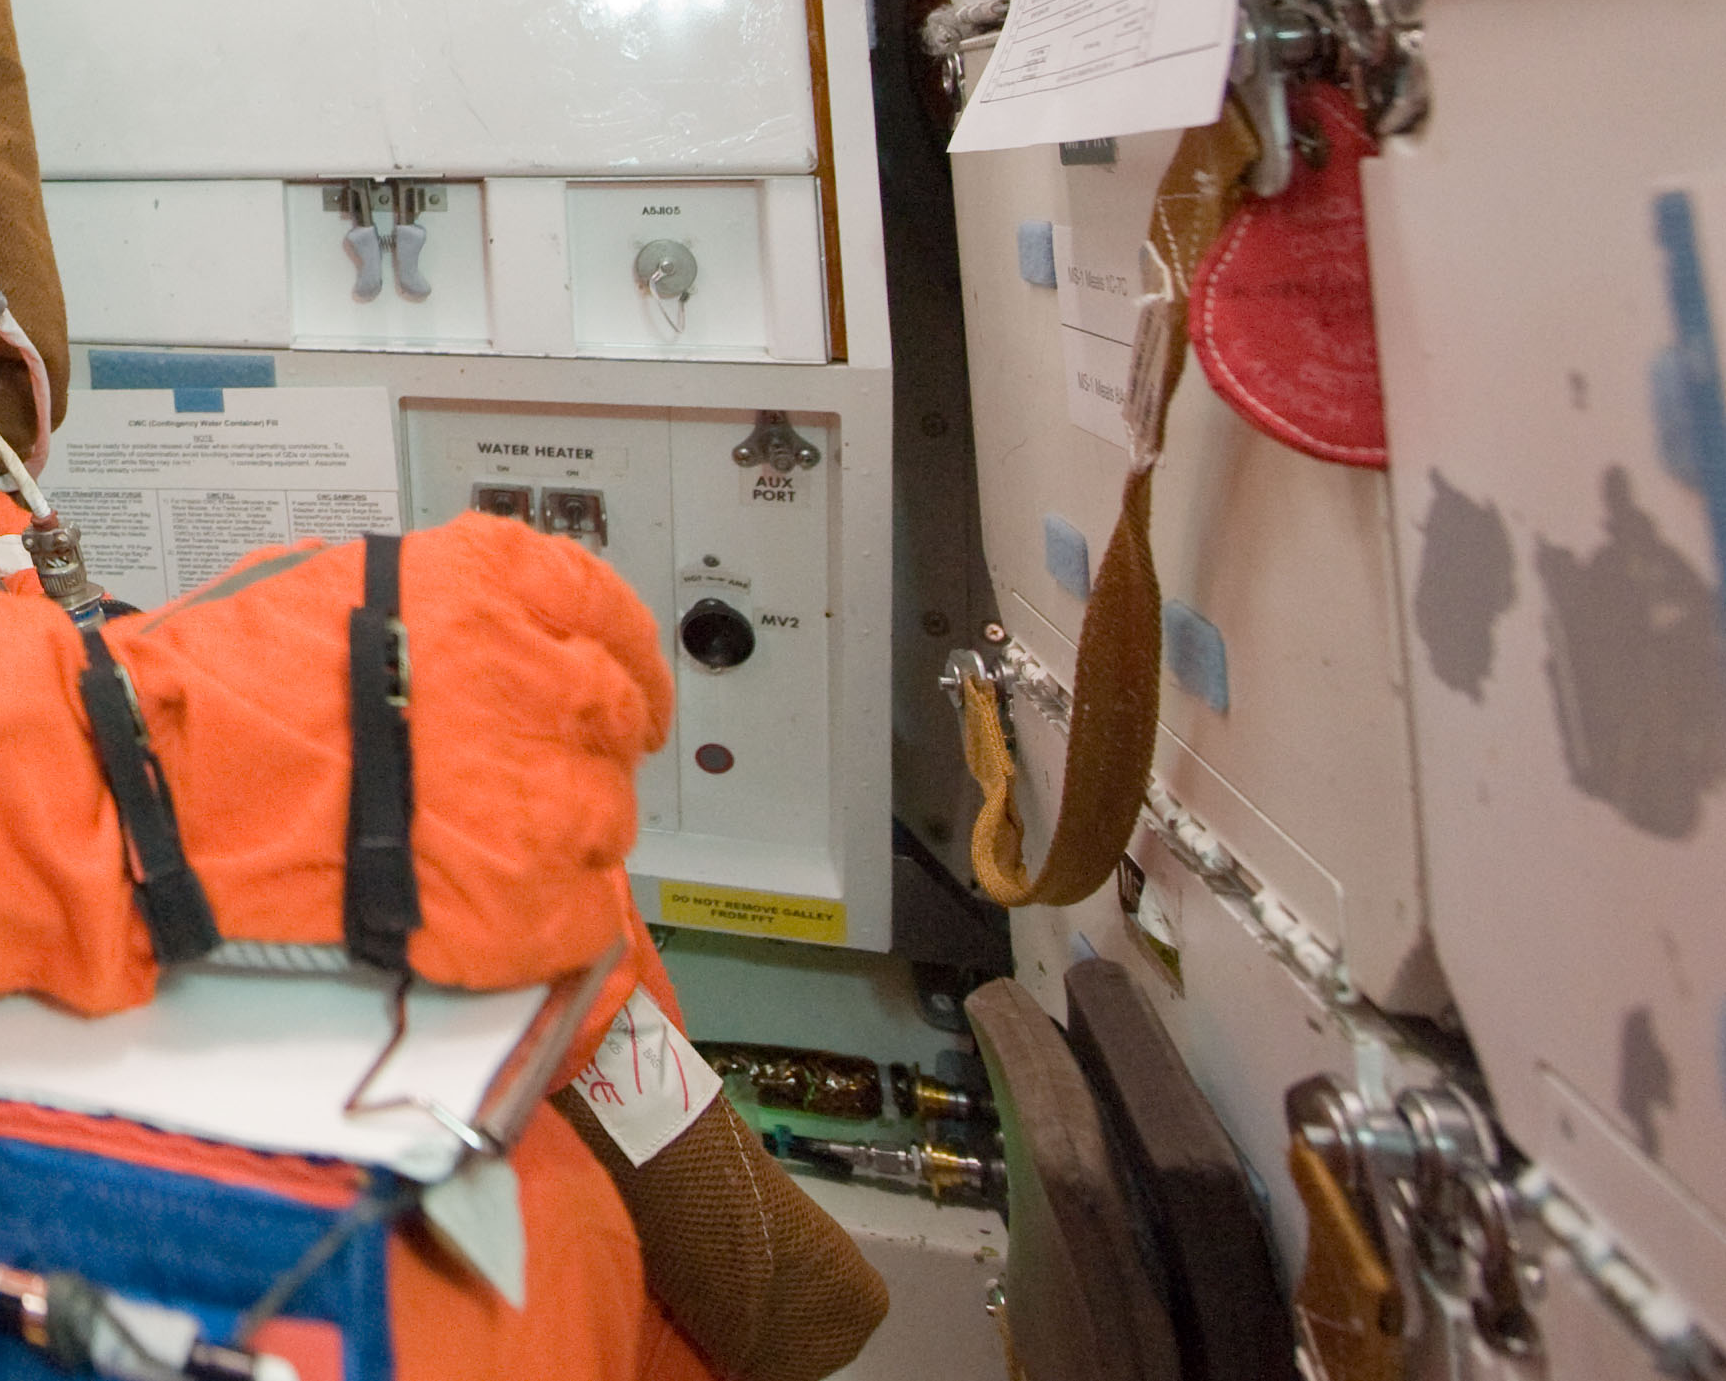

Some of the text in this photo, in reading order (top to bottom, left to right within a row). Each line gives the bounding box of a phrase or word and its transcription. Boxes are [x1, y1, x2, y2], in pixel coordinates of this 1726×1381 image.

[477, 442, 594, 460] WATER HEATER
[755, 475, 794, 489] AUX
[753, 489, 796, 503] PORT
[761, 613, 800, 629] MV2
[671, 893, 834, 922] DO NOT REMOVE GALLEY
[710, 908, 747, 921] FROM
